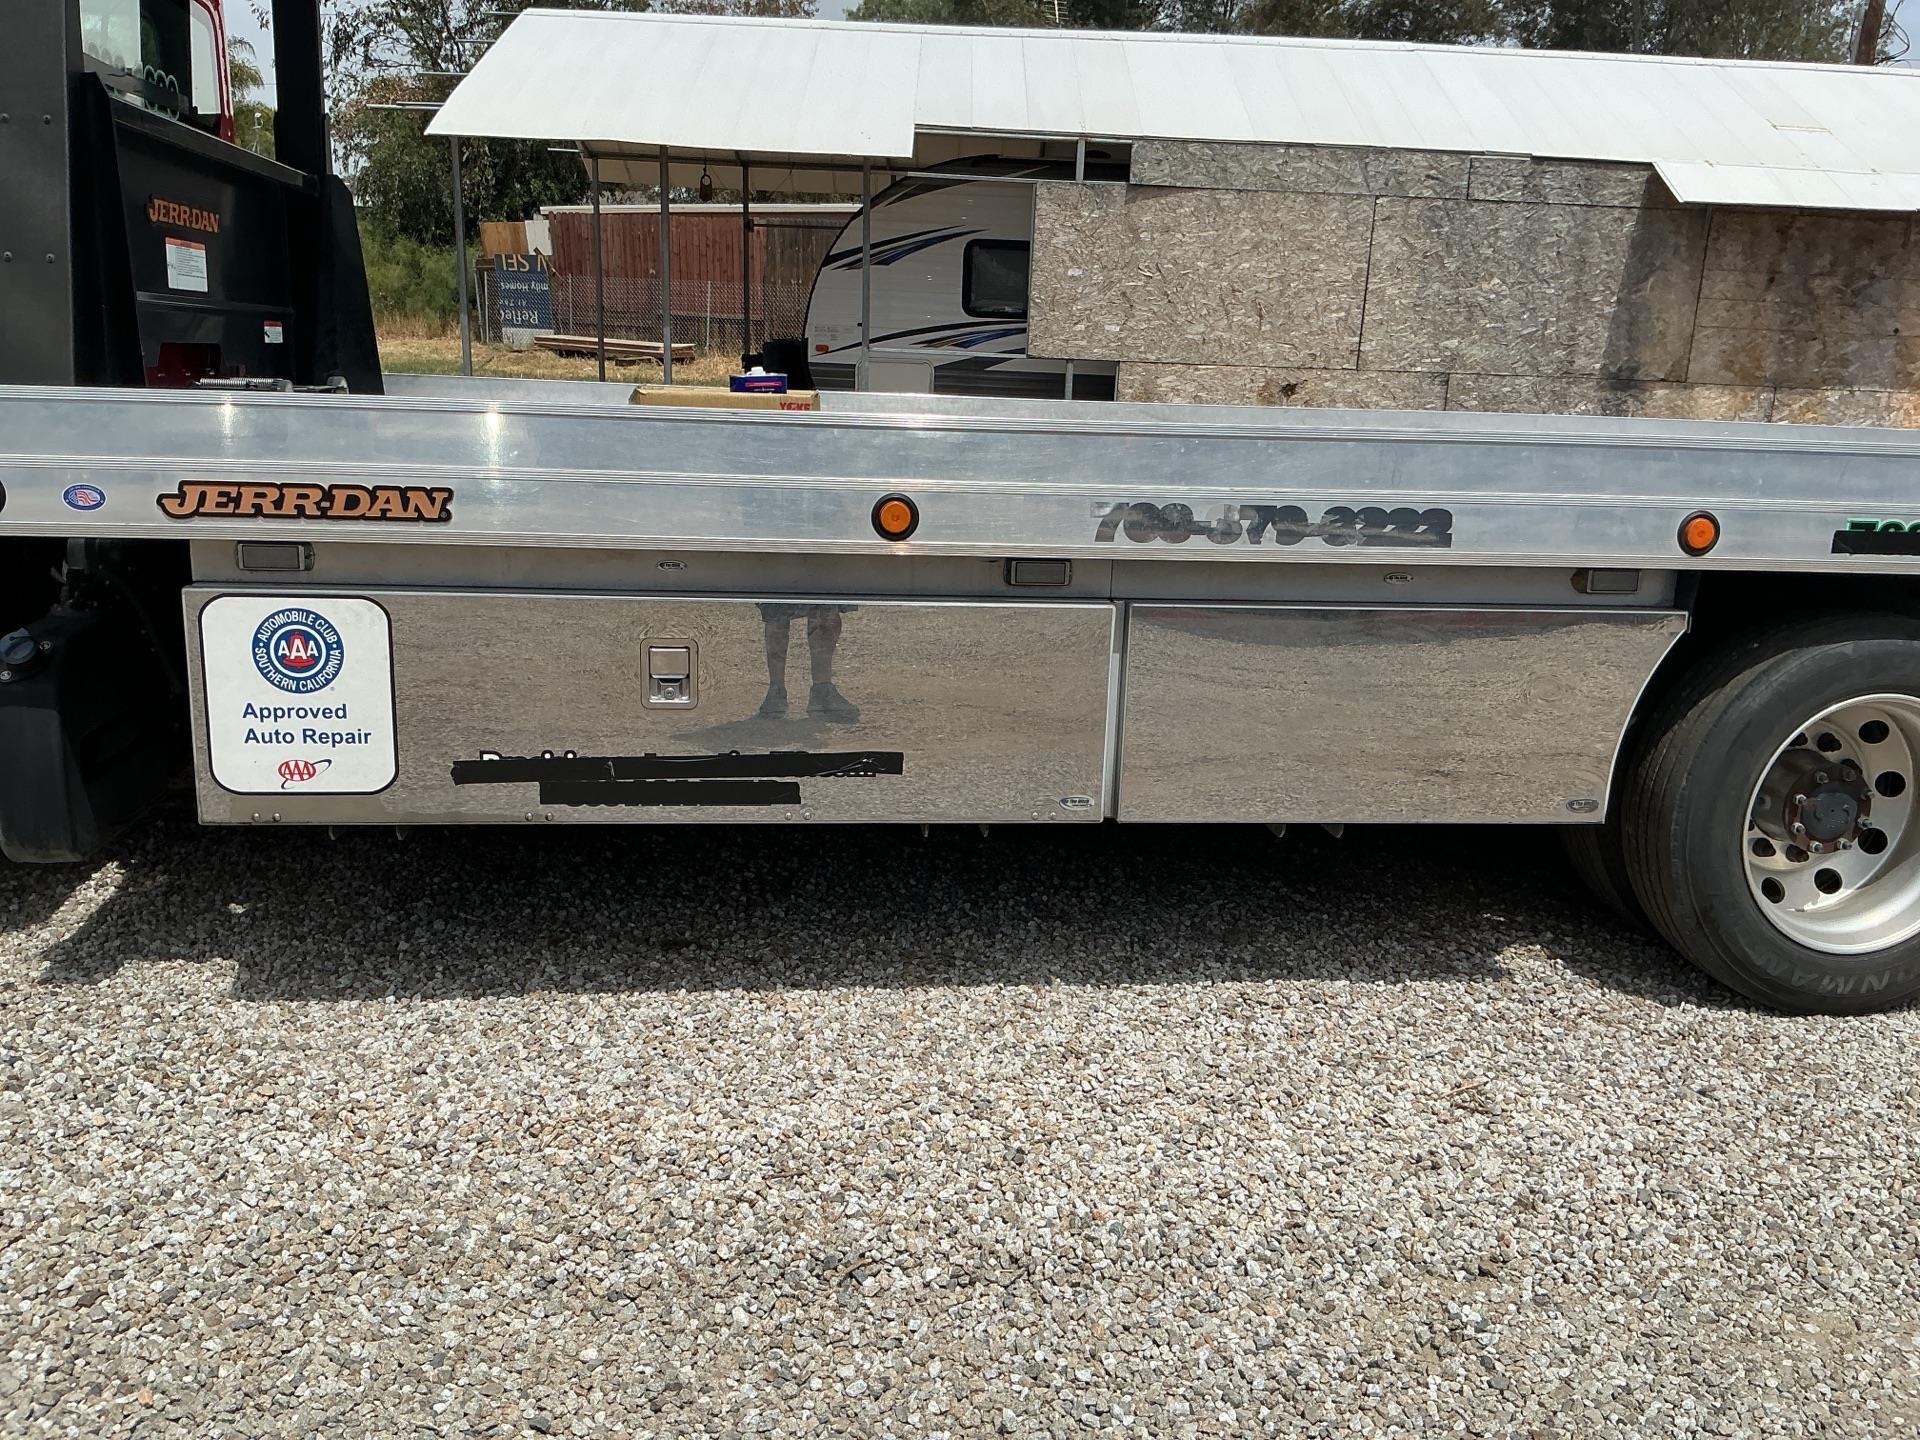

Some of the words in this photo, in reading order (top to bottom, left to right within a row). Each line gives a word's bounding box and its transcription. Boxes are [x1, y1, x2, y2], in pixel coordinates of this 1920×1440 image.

[500, 282, 529, 292] Homes
[257, 610, 316, 643] AUTOMOBILE
[314, 619, 338, 644] CLUB
[277, 638, 319, 660] AAA
[254, 646, 297, 692] SOUTHERN
[299, 648, 342, 692] CALIFORNIA
[242, 702, 347, 723] Approved
[244, 728, 295, 744] Auto
[302, 728, 372, 748] Repair
[279, 760, 317, 781] AAA
